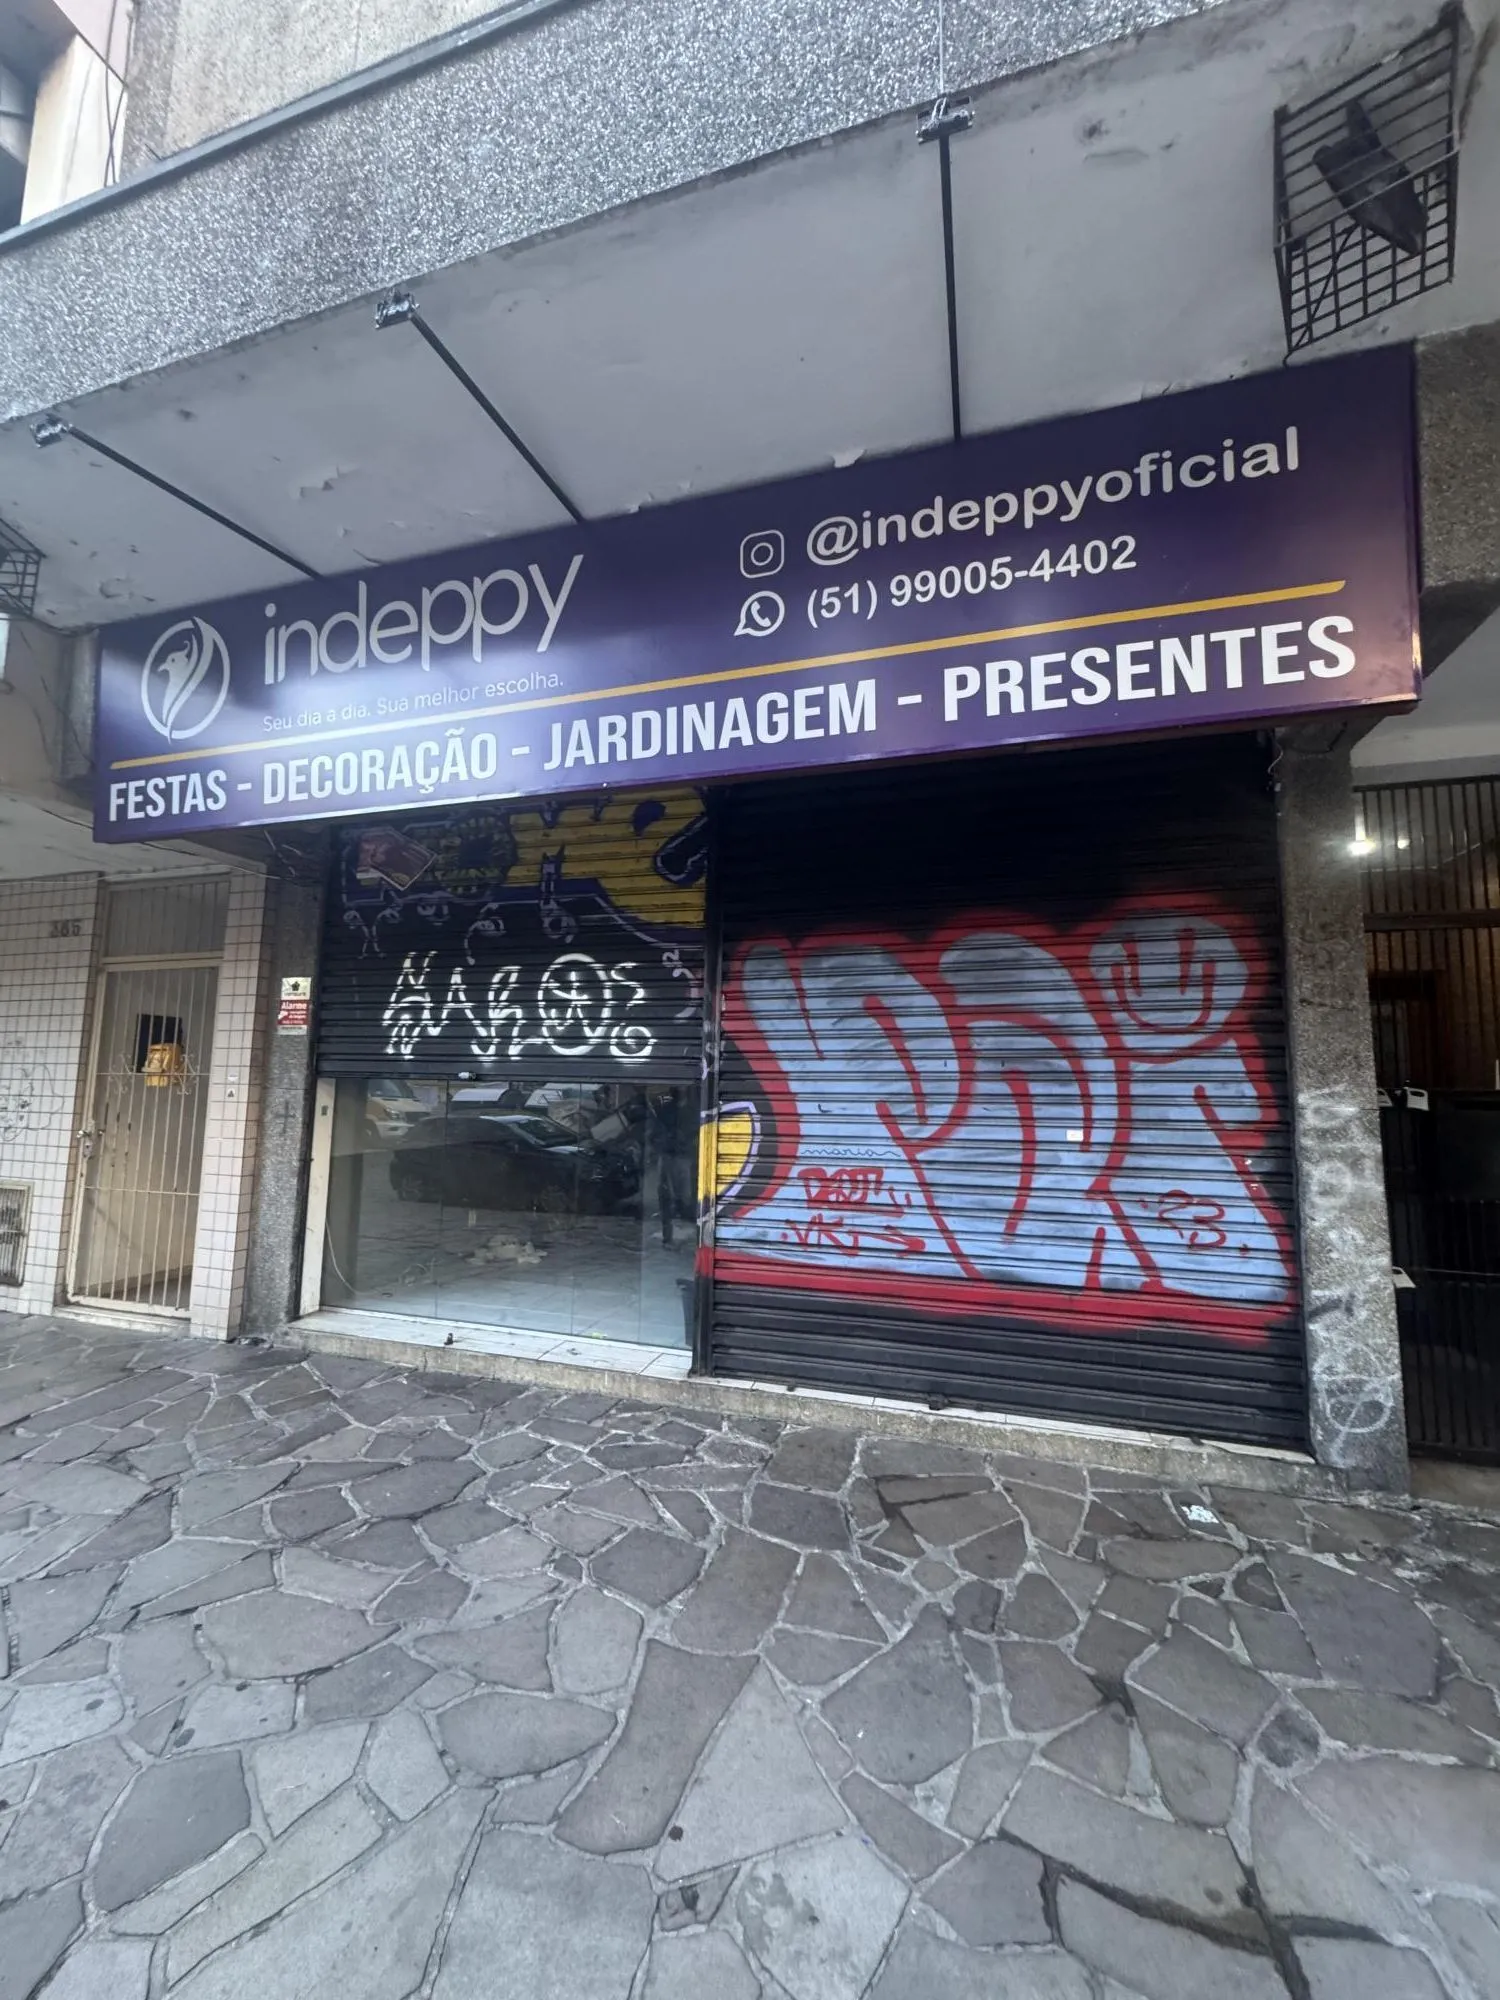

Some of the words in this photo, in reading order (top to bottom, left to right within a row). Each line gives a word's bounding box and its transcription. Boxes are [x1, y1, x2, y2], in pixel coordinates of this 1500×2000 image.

[807, 426, 1298, 566] @indeppyoficial
[264, 554, 584, 685] indeppy
[806, 583, 878, 629] (51)
[889, 534, 1137, 608] 99005-4402
[108, 769, 228, 823] FESTAS
[236, 781, 252, 792] -
[262, 727, 498, 805] DECORAÇÃO
[512, 744, 530, 756] -
[543, 678, 877, 771] JARDINAGEM
[897, 693, 922, 707] -
[943, 614, 1356, 722] PRESENTES
[263, 715, 292, 732] Seu
[296, 709, 322, 727] dia
[326, 709, 337, 722] a
[342, 703, 371, 720] dia.
[377, 697, 409, 715] Sua
[414, 685, 479, 709] melhor
[485, 671, 564, 697] escolha.
